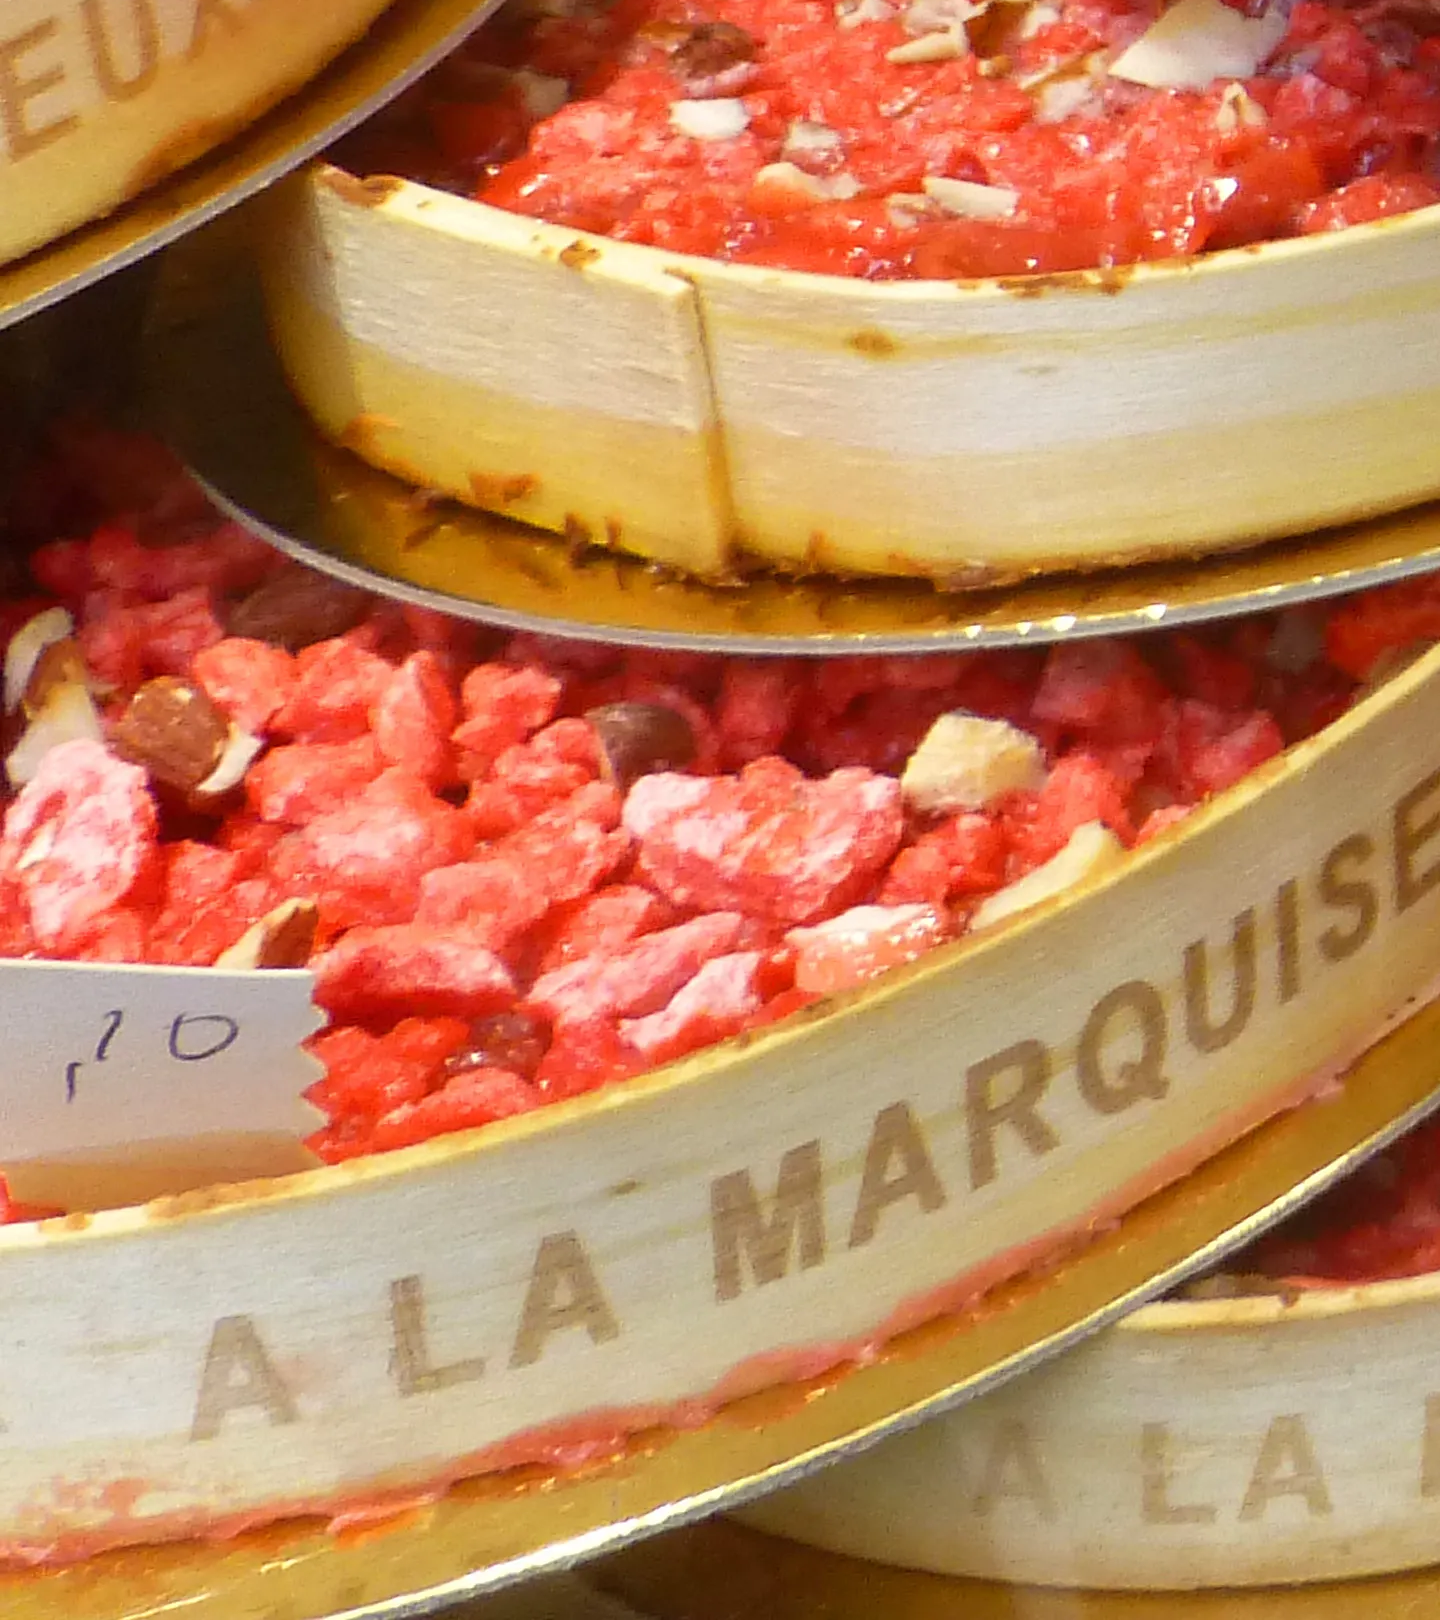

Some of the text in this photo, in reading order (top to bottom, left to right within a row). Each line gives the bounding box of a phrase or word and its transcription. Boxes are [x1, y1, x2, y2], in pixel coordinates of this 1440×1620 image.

[189, 1313, 300, 1444] A
[388, 1227, 621, 1398] LA
[970, 1419, 1061, 1525] A
[1138, 1413, 1335, 1527] LA
